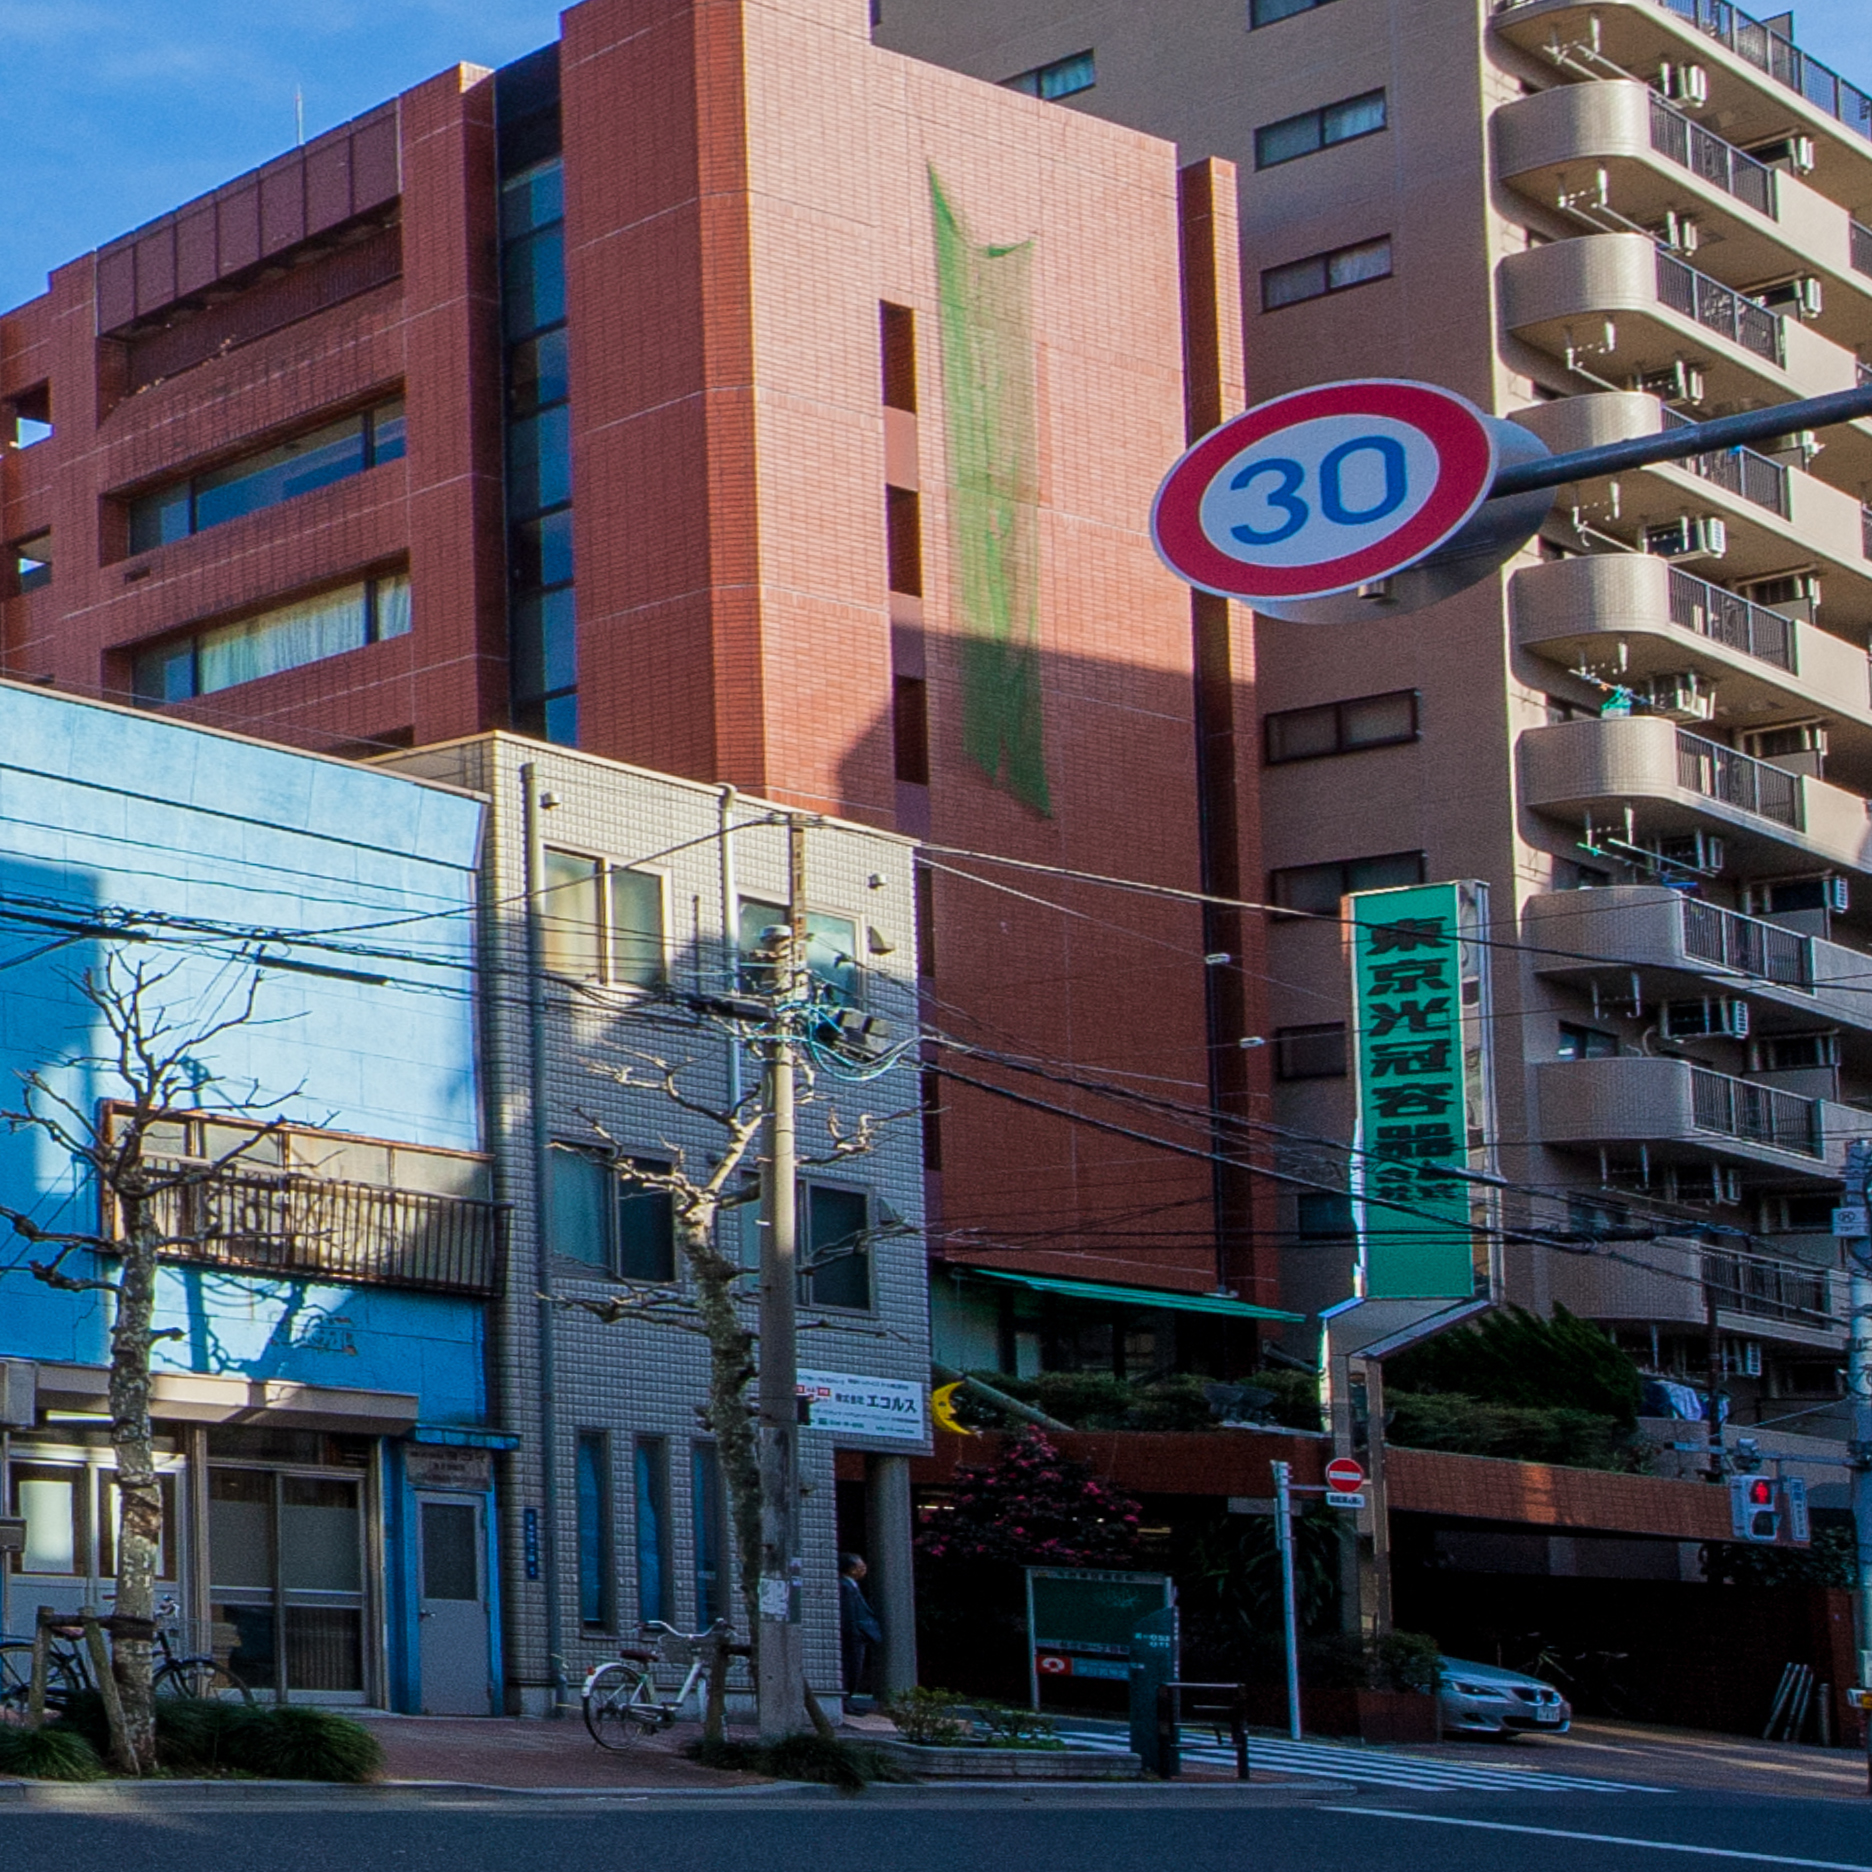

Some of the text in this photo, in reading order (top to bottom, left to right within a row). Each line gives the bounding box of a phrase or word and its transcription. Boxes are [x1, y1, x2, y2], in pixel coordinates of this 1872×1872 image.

[1230, 434, 1408, 546] 30
[866, 1394, 917, 1414] エコルス
